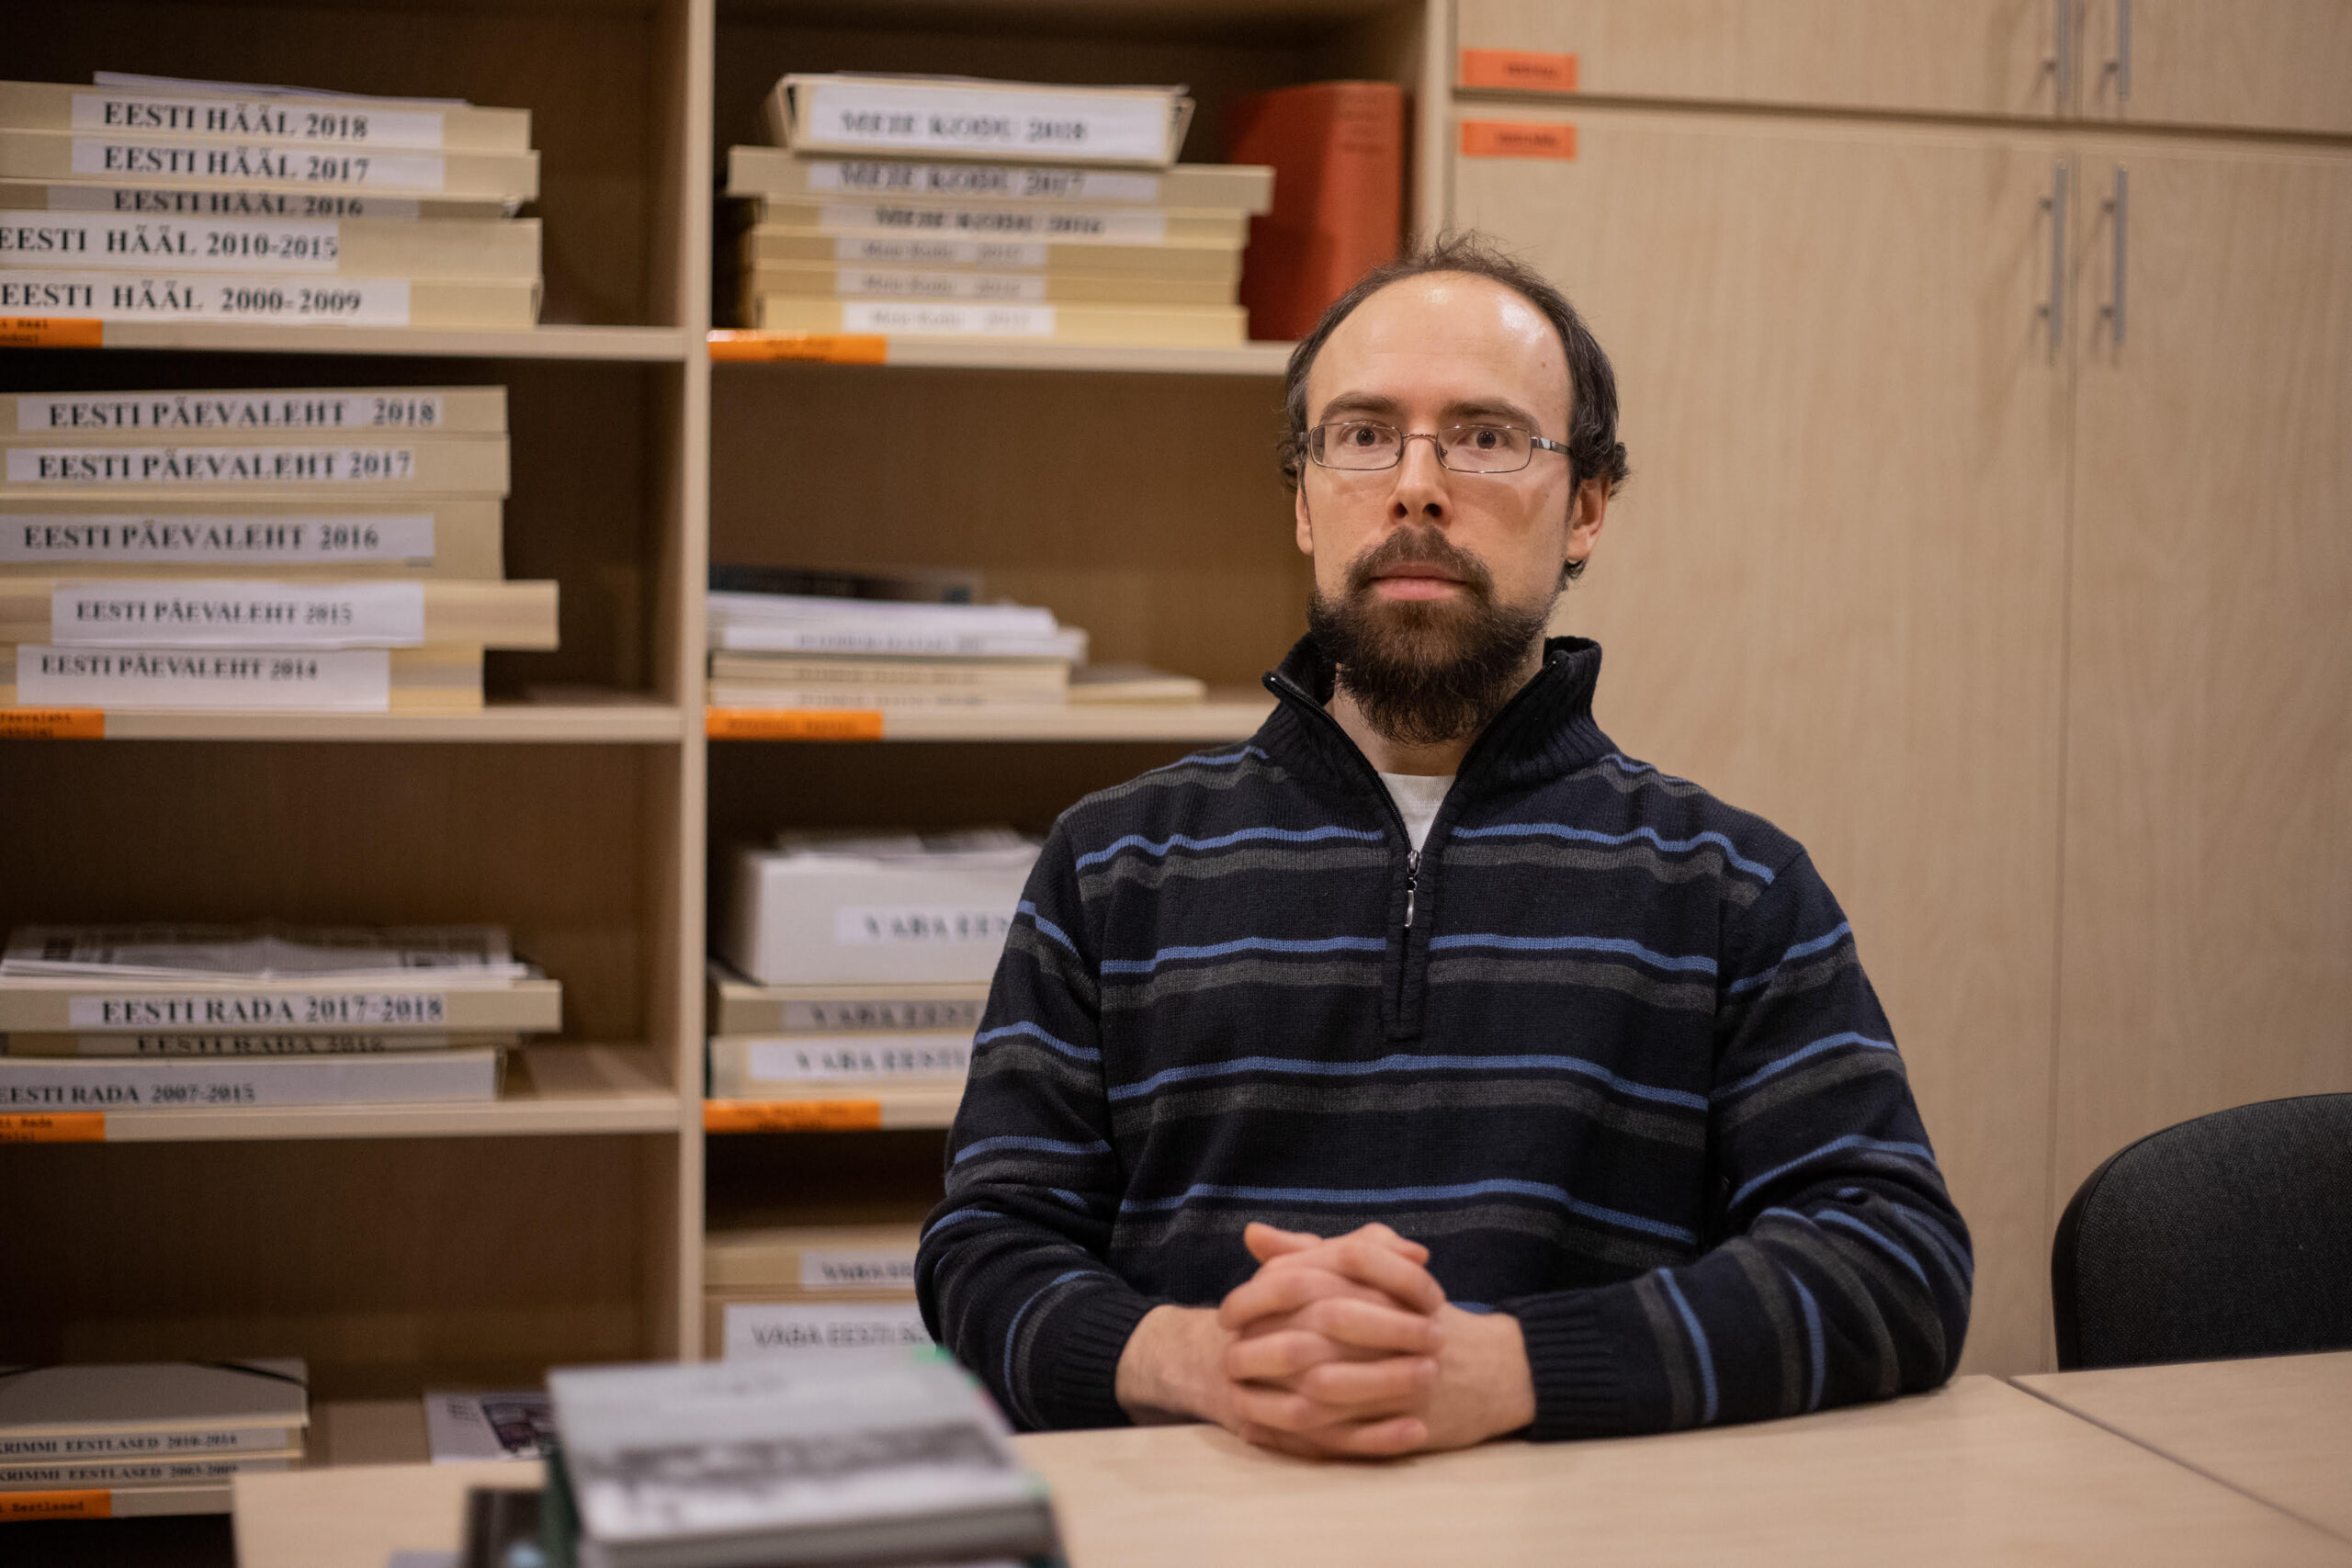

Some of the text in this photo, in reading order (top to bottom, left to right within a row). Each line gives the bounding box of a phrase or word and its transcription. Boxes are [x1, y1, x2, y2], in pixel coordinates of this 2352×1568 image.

[104, 101, 368, 139] EESTI HÄÄL 2018
[104, 146, 369, 182] EESTI HÄÄL 2017
[114, 190, 364, 219] EESTI HÄÄL 2016
[106, 223, 196, 257] HÄÄL
[205, 230, 338, 259] 2010-2015
[1, 279, 361, 315] EESTI HÄÄL 2000-2009
[49, 395, 435, 429] EESTI PÄEVALEHT 2018
[39, 447, 411, 479] EESTI PÄEVALEHT 2017
[24, 518, 379, 549] EESTI PÄEVALEHT 2016
[77, 600, 145, 622] EESTI
[153, 596, 298, 624] PÄEVALEHT
[41, 654, 110, 676] EESTI
[119, 651, 262, 678] PÄEVALEHT
[102, 995, 444, 1024] EESTI RADA 2017-2018
[137, 1035, 224, 1054] EESTI
[232, 1035, 321, 1054] RADA
[72, 1085, 139, 1101] RADA
